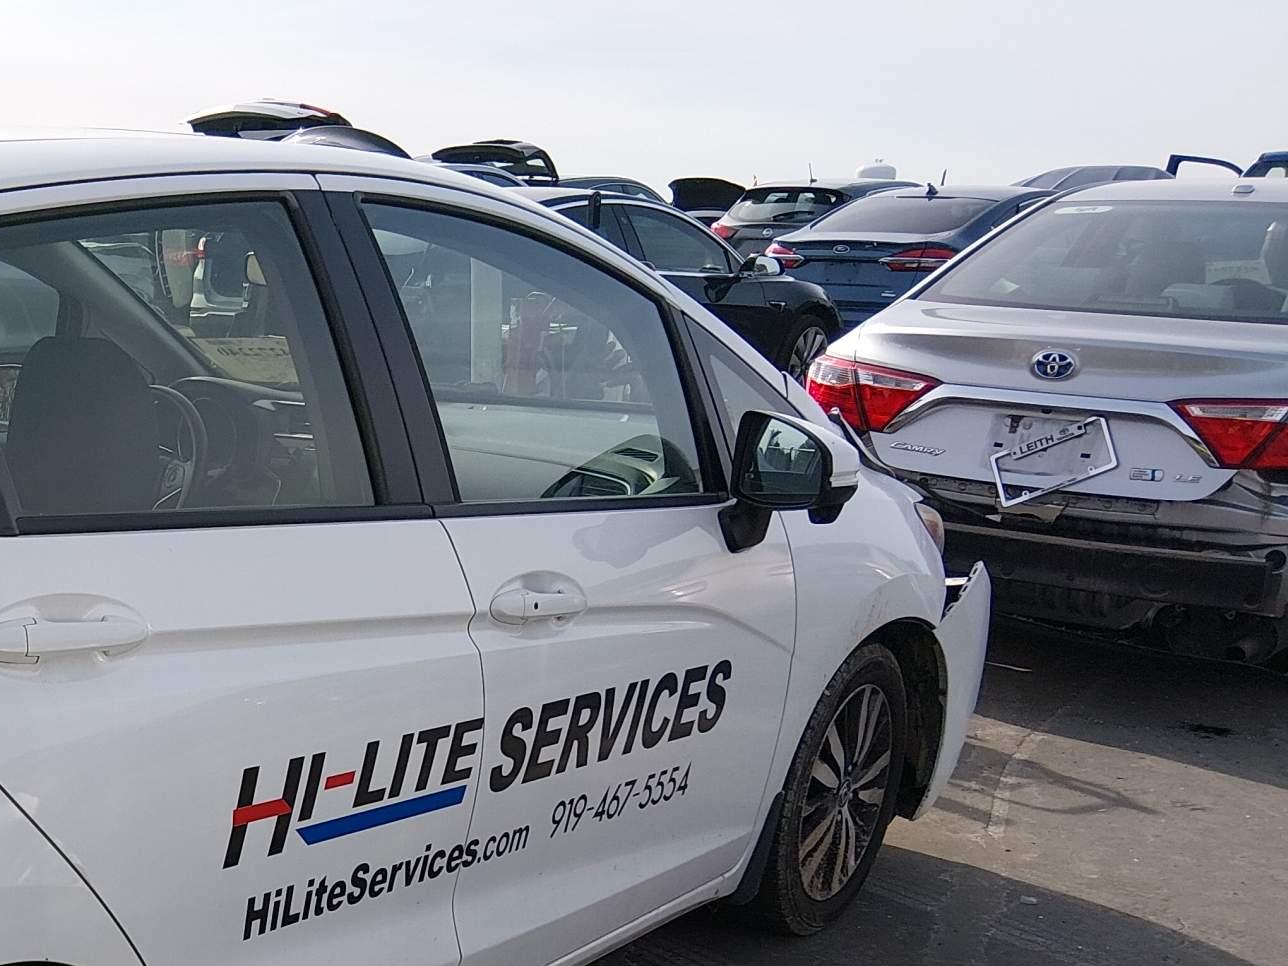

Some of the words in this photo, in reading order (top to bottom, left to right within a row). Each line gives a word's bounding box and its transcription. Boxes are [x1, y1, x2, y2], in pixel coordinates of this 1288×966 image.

[889, 441, 946, 457] CAMRY
[1018, 434, 1055, 455] LEITH
[222, 717, 486, 870] HI-LITE
[489, 659, 733, 793] SERVICES
[549, 761, 692, 839] 919-467-5554
[242, 823, 530, 942] HiLiteServices.com
